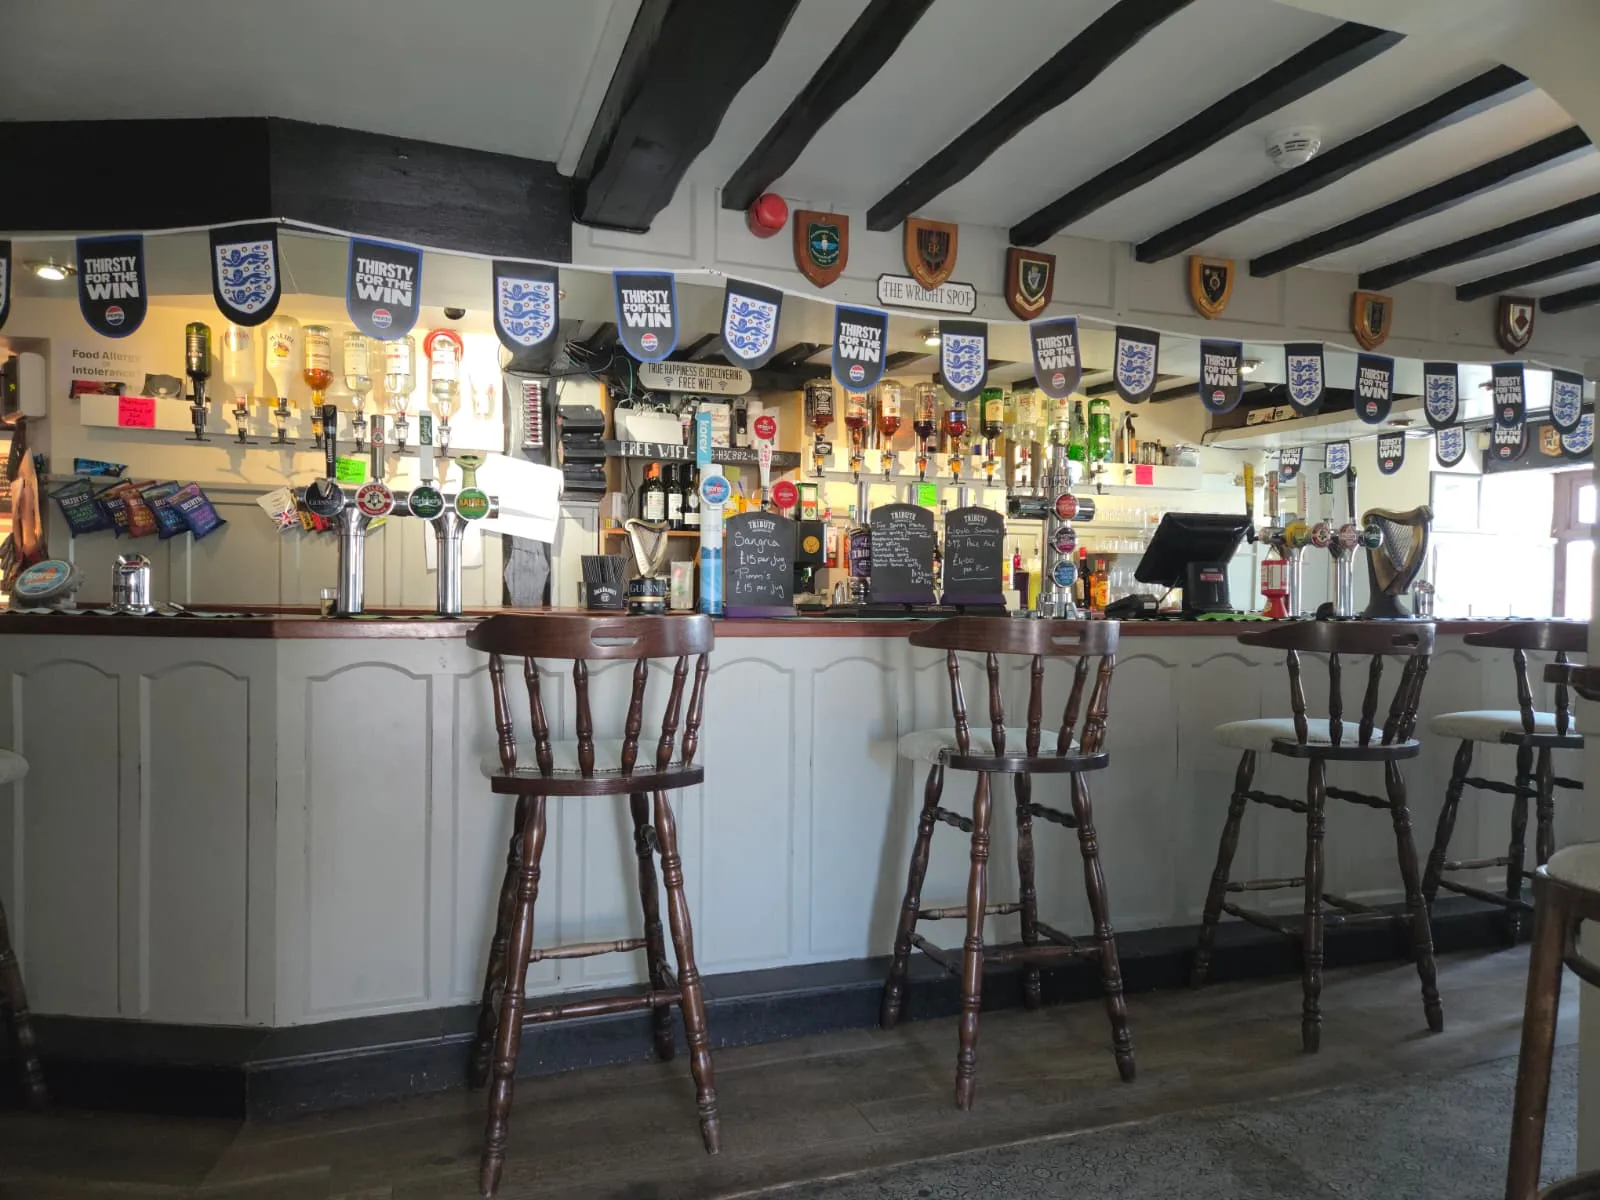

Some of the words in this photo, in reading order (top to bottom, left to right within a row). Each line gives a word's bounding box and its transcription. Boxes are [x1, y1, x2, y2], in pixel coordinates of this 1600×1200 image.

[84, 256, 136, 273] THIRSTY
[357, 258, 413, 280] THIRSTY
[85, 273, 110, 283] FOR
[112, 272, 137, 282] THE
[356, 273, 383, 286] FOR
[385, 278, 413, 291] THE
[86, 282, 139, 300] WIN
[356, 283, 412, 307] WIN
[622, 289, 668, 304] THIRSTY
[882, 281, 903, 298] THE
[905, 284, 945, 304] WRIGHT
[947, 289, 973, 306] SPOT
[623, 304, 646, 313] FOR
[649, 304, 671, 313] THE
[624, 313, 672, 328] WIN
[840, 322, 881, 341] THIRSTY
[840, 335, 860, 346] FOR
[861, 339, 880, 349] THE
[1036, 335, 1073, 351] THIRSTY
[72, 350, 99, 360] Food
[102, 351, 140, 362] Allergy
[839, 344, 880, 363] WIN
[1037, 349, 1056, 358] FOR
[1057, 347, 1074, 356] THE
[1039, 356, 1075, 370] WIN
[1204, 354, 1237, 367] THIRSTY
[648, 363, 664, 375] TRUE
[664, 364, 698, 376] HAPPINESS
[698, 367, 705, 377] IS
[706, 367, 743, 381] DISCOVERING
[1204, 366, 1220, 374] FOR
[1220, 367, 1237, 375] THE
[1360, 368, 1389, 381] THIRSTY
[679, 376, 695, 389] FREE
[697, 378, 713, 390] WIFI
[1204, 372, 1238, 387] WIN
[1359, 378, 1373, 386] FOR
[1374, 380, 1389, 388] THE
[1359, 385, 1388, 400] WIN
[1495, 435, 1521, 445] WIN
[620, 441, 653, 457] FREE
[657, 444, 689, 460] WIFI
[1281, 456, 1299, 465] WIN
[890, 511, 917, 521] TRIBUTE
[964, 514, 988, 524] TRIBUTE
[748, 519, 776, 531] TRIBUTE
[734, 532, 780, 553] Sangria
[740, 550, 756, 565] £15
[757, 556, 770, 564] per
